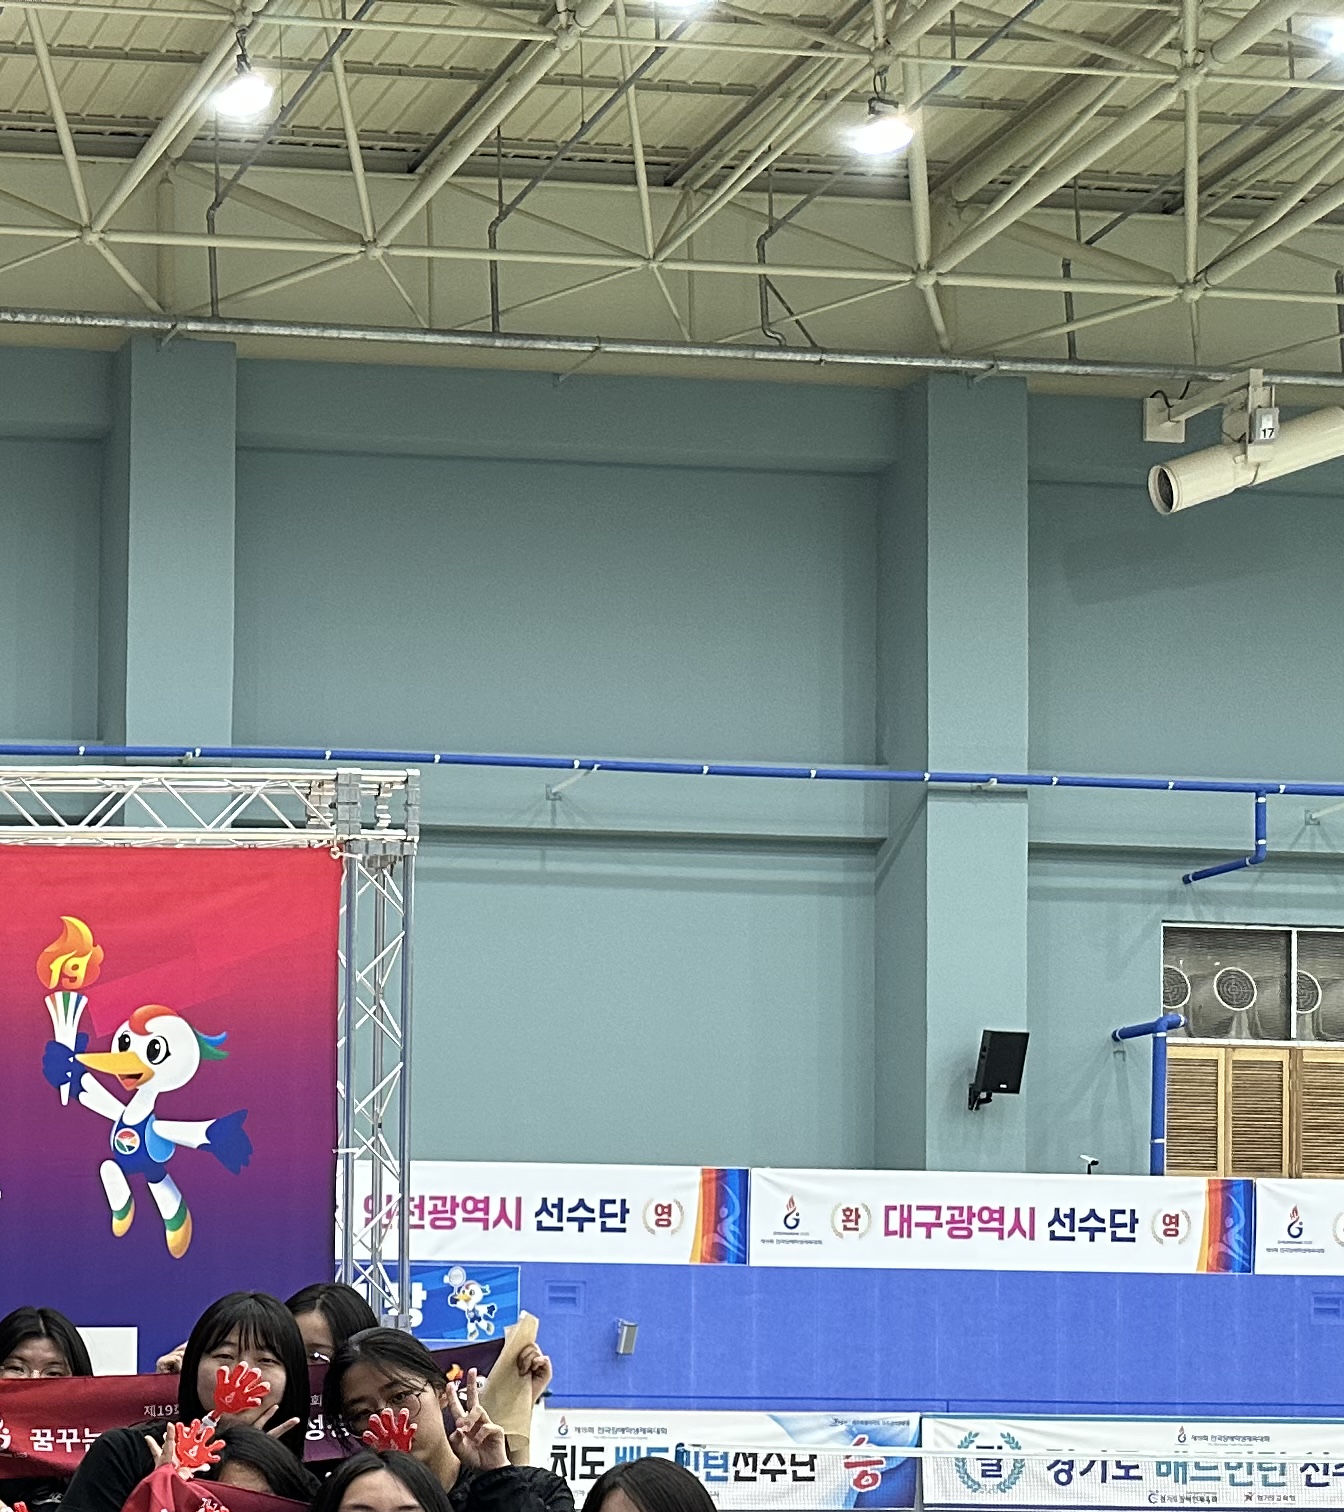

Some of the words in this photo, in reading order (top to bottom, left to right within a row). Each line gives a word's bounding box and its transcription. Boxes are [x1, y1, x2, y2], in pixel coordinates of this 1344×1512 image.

[534, 1196, 631, 1233] 선수단
[653, 1204, 673, 1229] 영
[841, 1206, 861, 1232] 환
[883, 1203, 1036, 1241] 대구광역시
[1047, 1207, 1140, 1243] 선수단
[1162, 1213, 1180, 1238] 영
